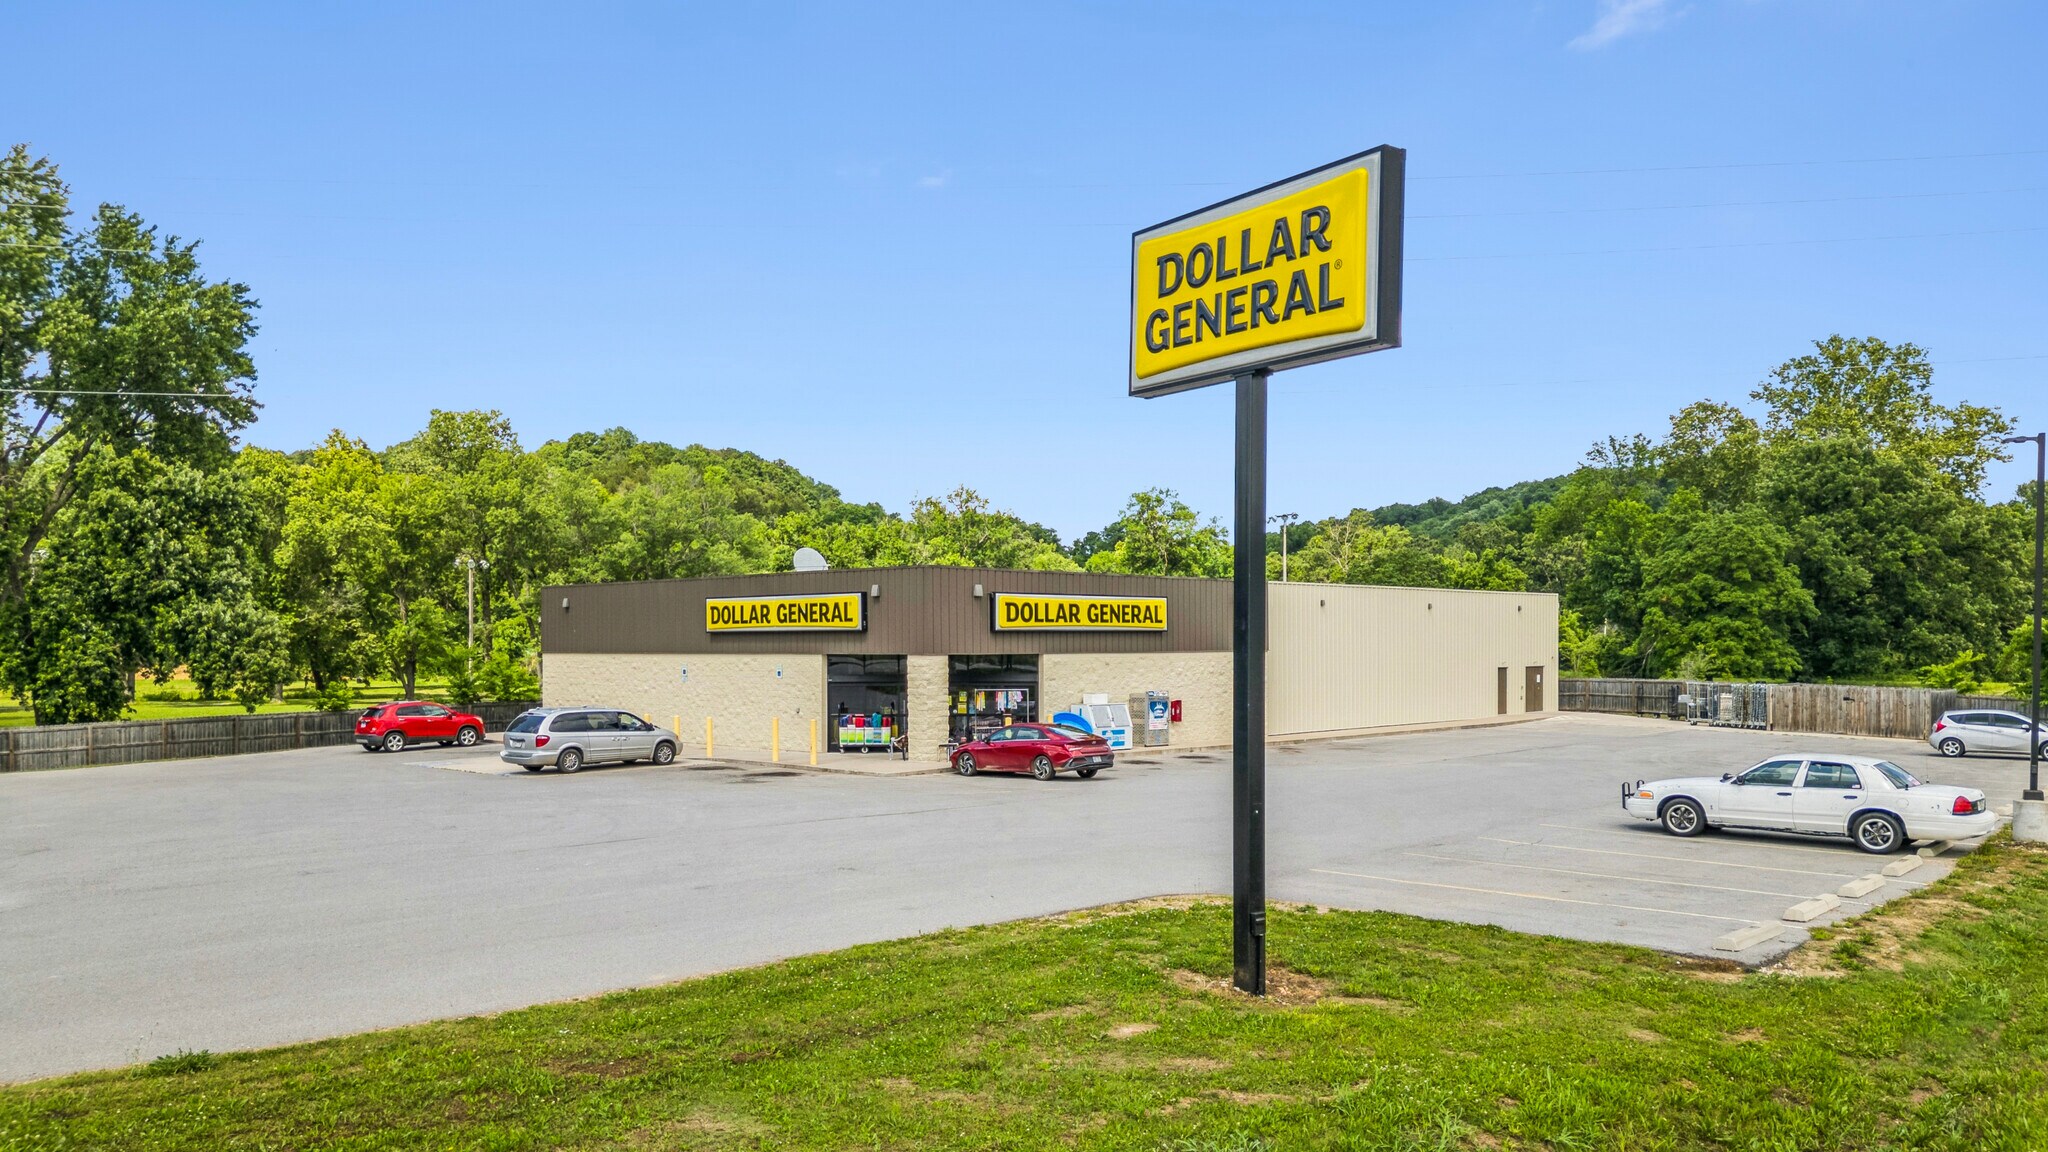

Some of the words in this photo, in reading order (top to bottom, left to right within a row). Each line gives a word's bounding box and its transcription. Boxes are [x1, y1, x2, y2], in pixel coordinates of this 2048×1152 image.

[1157, 205, 1332, 299] DOLLAR
[710, 604, 771, 624] DOLLAR
[776, 602, 853, 623] GENERAL
[1005, 602, 1081, 623] DOLLAR
[1087, 604, 1163, 623] GENERAL
